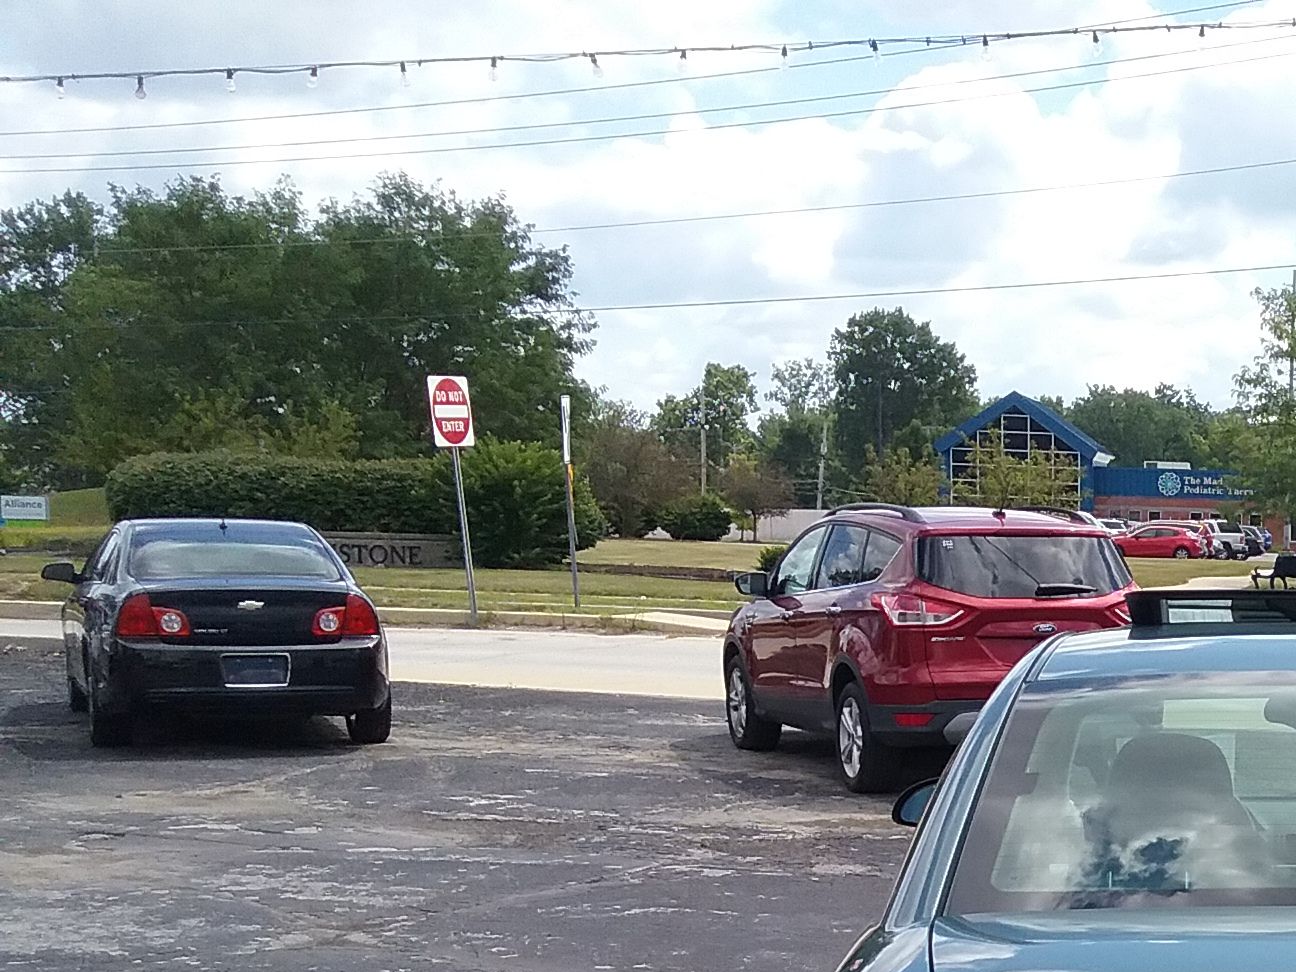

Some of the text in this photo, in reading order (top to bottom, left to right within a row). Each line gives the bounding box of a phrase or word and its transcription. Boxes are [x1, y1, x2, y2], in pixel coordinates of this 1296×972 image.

[436, 390, 463, 402] DO NOT
[442, 421, 464, 432] ENTER
[1183, 476, 1199, 485] The
[1183, 486, 1223, 495] Pediatric
